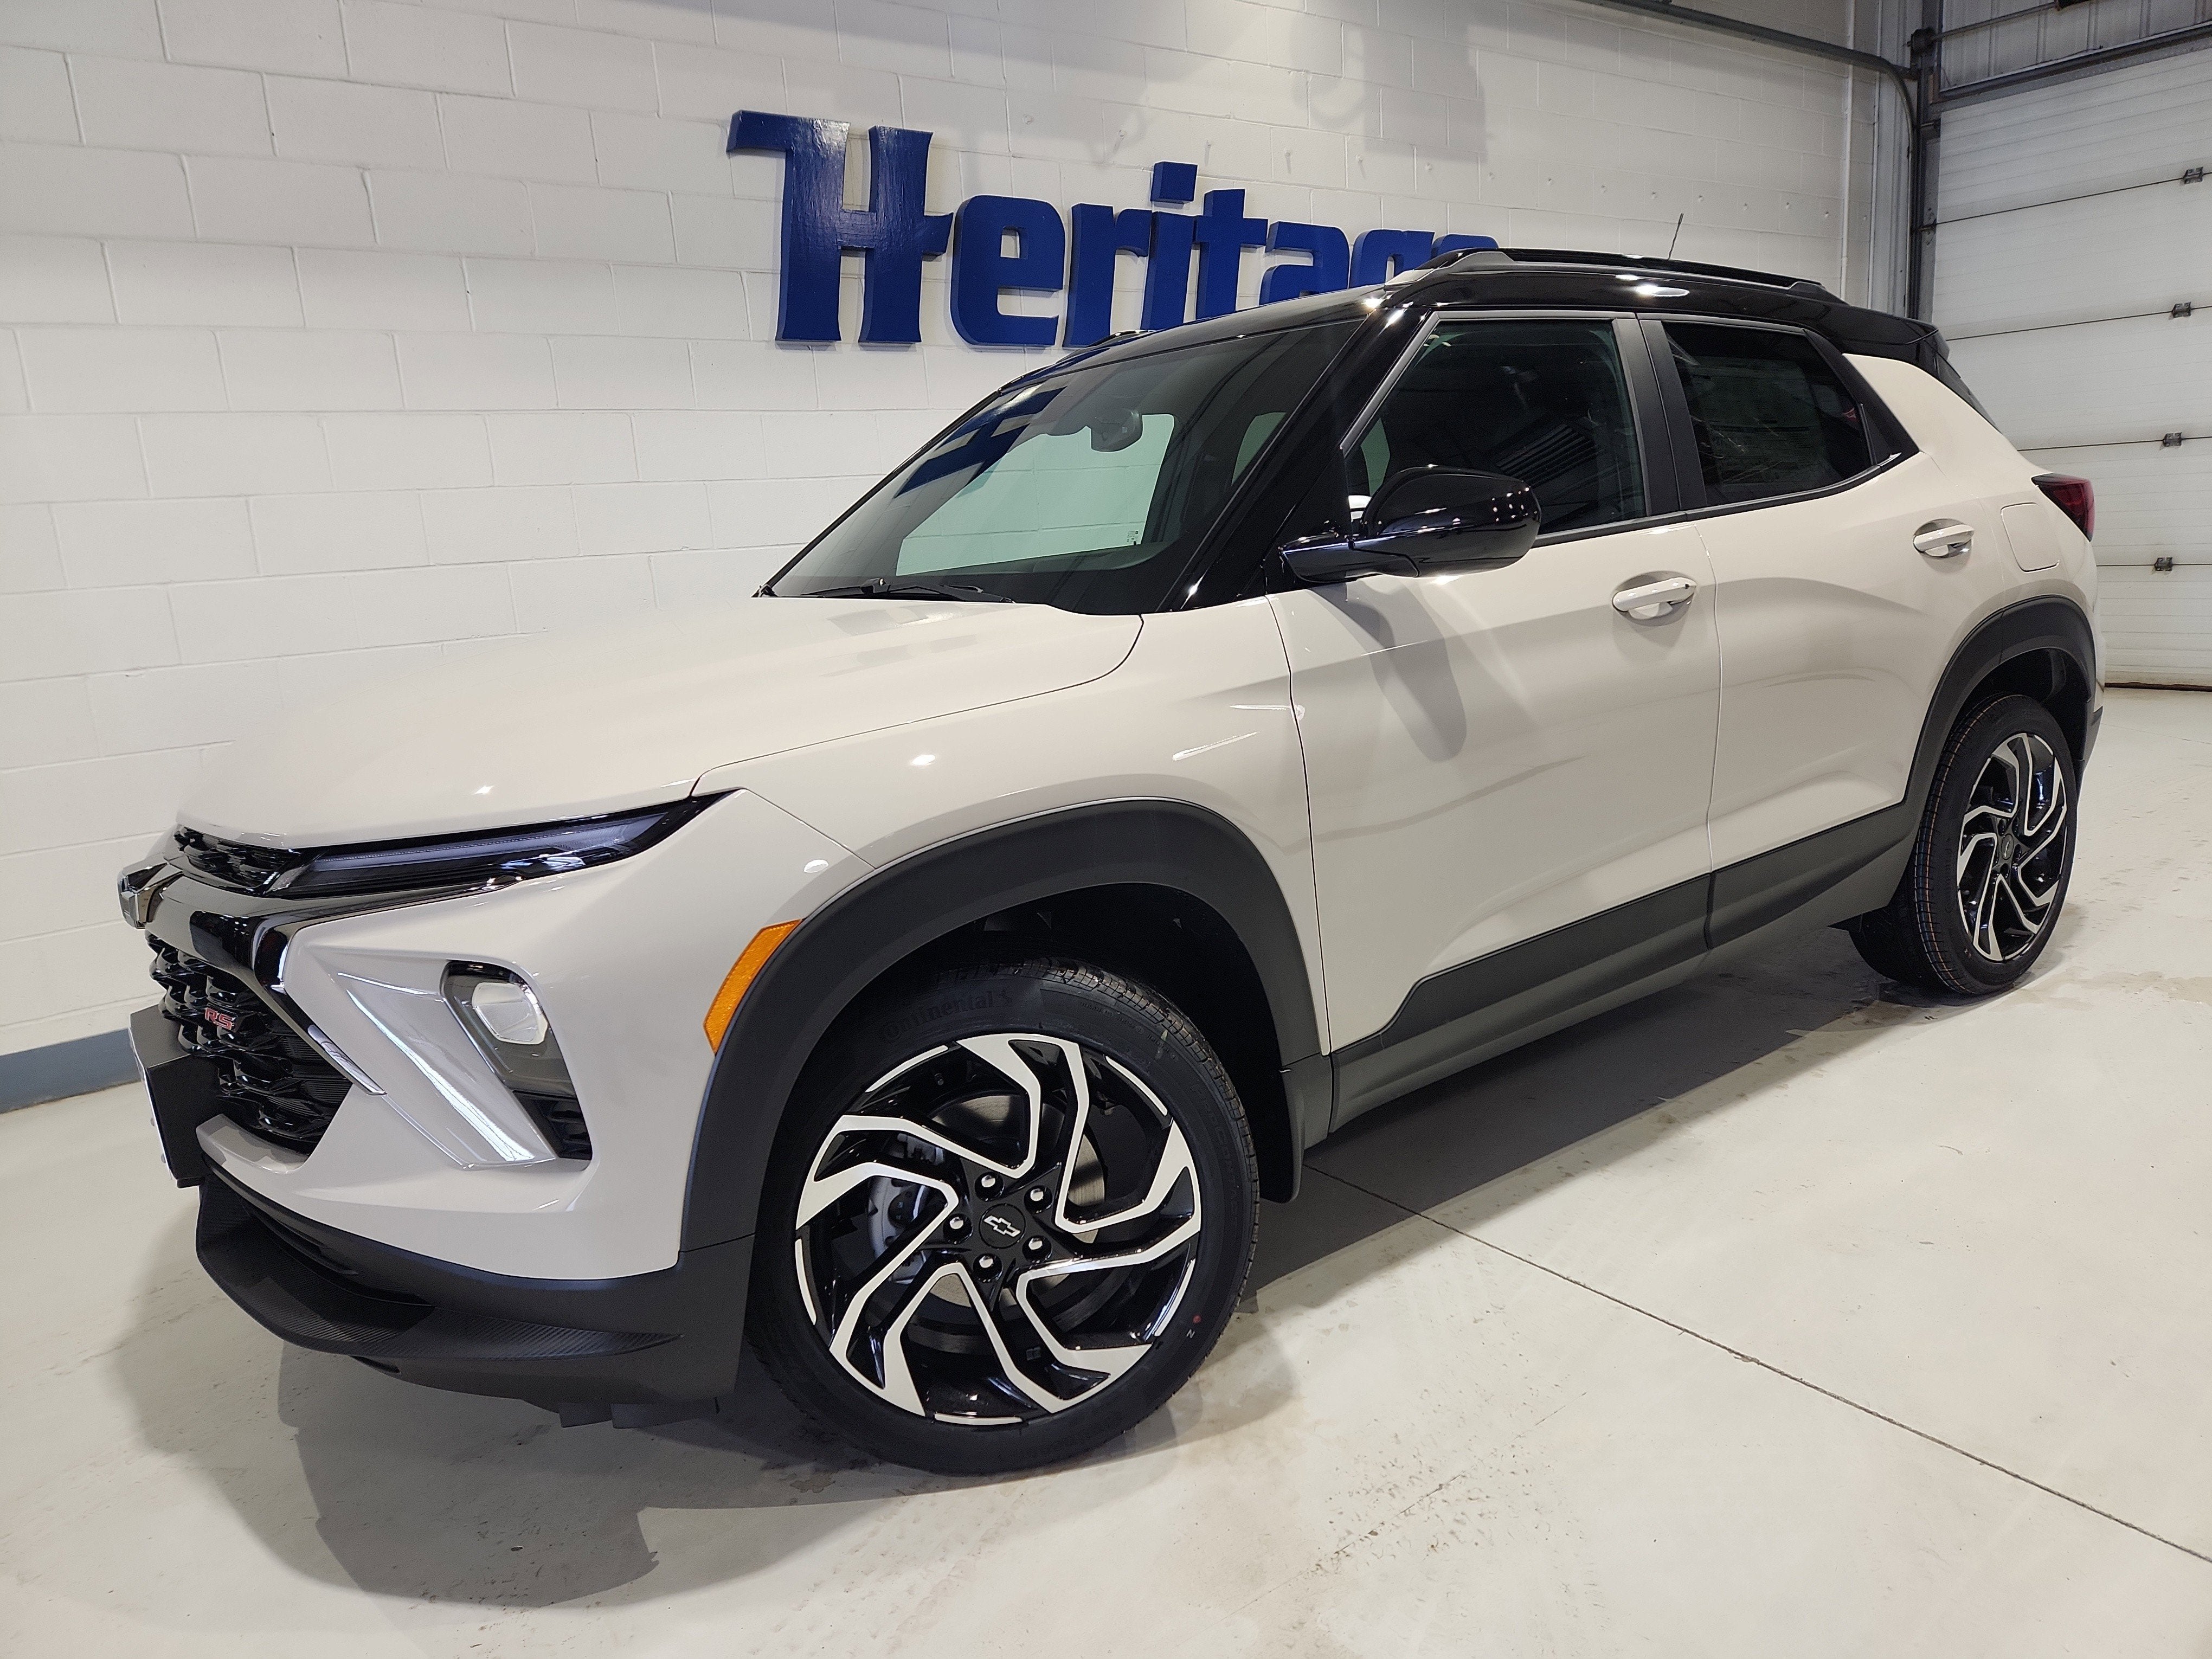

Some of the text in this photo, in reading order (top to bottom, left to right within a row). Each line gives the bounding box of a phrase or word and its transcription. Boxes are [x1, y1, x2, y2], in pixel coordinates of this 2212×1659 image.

[727, 110, 1499, 346] Herita
[204, 1007, 235, 1030] RS
[879, 990, 994, 1044] Continental
